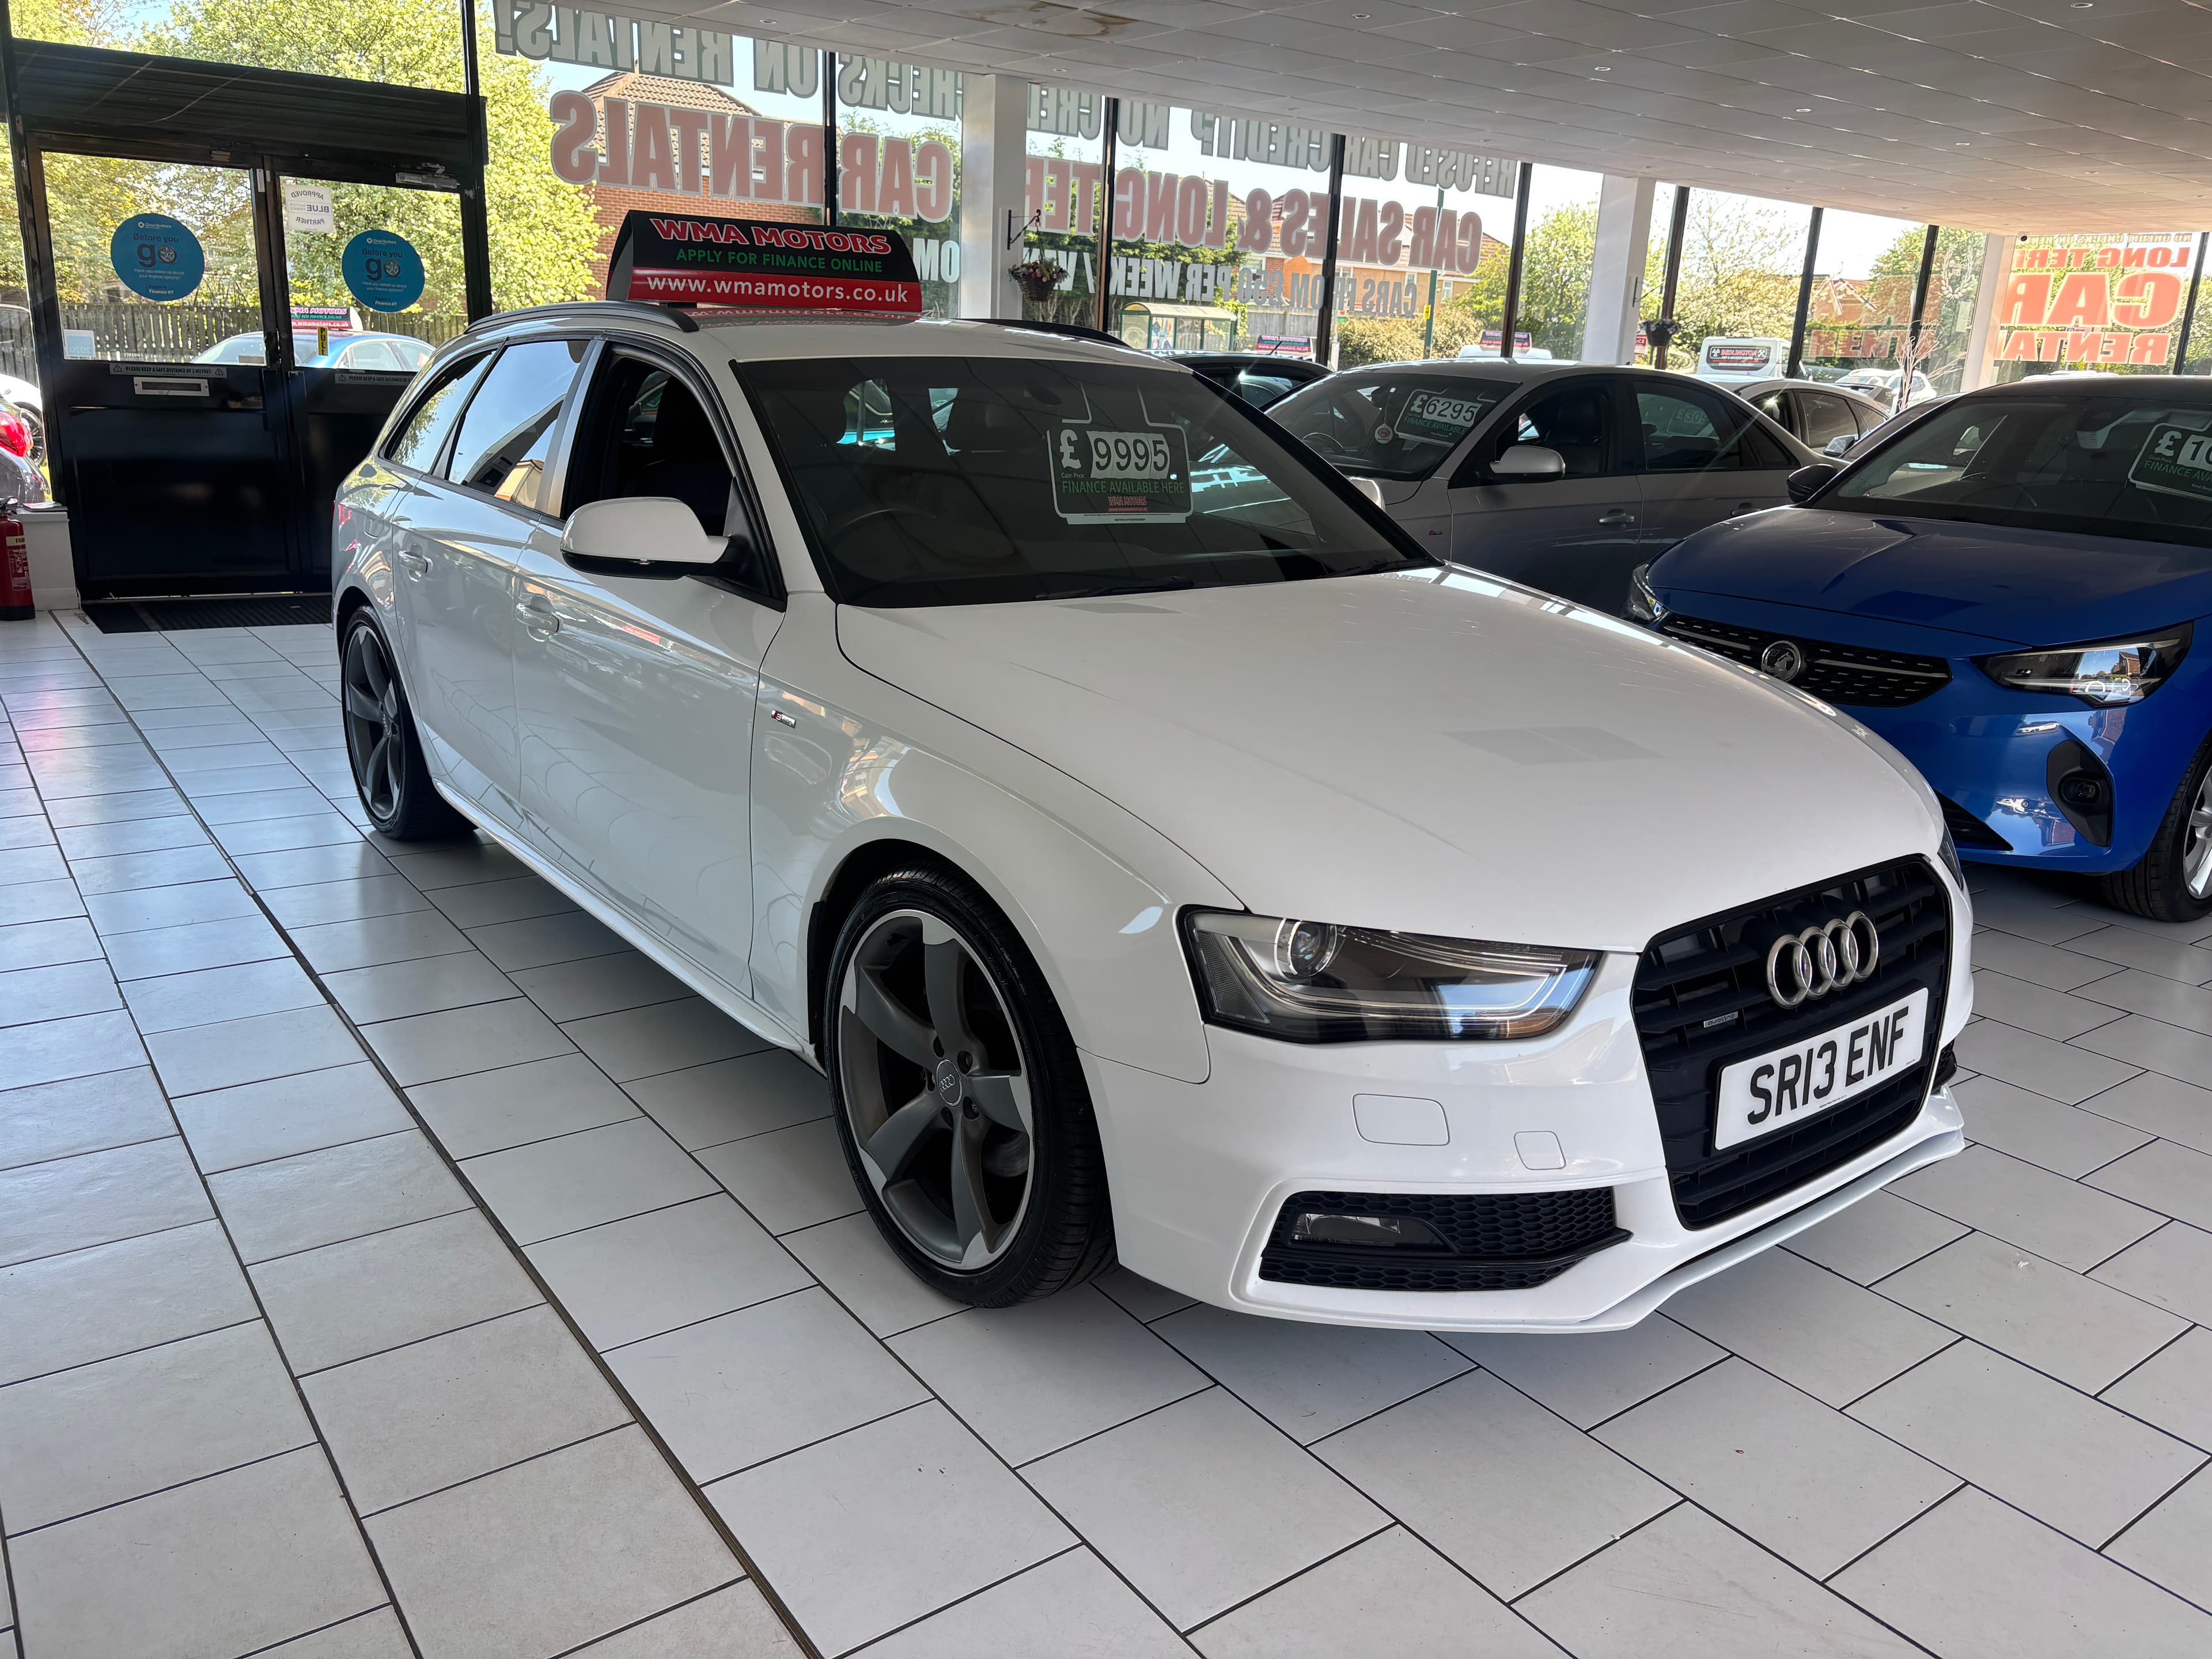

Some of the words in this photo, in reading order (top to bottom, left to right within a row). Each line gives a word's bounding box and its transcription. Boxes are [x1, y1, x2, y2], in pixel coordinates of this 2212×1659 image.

[133, 233, 161, 241] Before
[649, 218, 749, 245] WMA
[752, 226, 892, 254] MOTORS
[362, 248, 387, 256] Before
[676, 248, 722, 262] APPLY
[728, 251, 757, 266] FOR
[763, 254, 825, 269] FINANCE
[831, 257, 882, 272] ONLINE
[647, 275, 908, 303] www.wmamotors.co.uk
[1404, 416, 1431, 428] FINANCE
[1431, 422, 1467, 434] AVAILABLE
[2143, 461, 2191, 477] FINANCE
[1062, 480, 1107, 493] FINANCE
[1109, 481, 1160, 494] AVAILABLE
[1161, 482, 1185, 494] HERE
[1123, 496, 1147, 507] MOTORS
[1707, 1014, 1734, 1025] quattro
[1747, 1040, 1838, 1126] SR13
[1845, 1006, 1909, 1088] ENF
